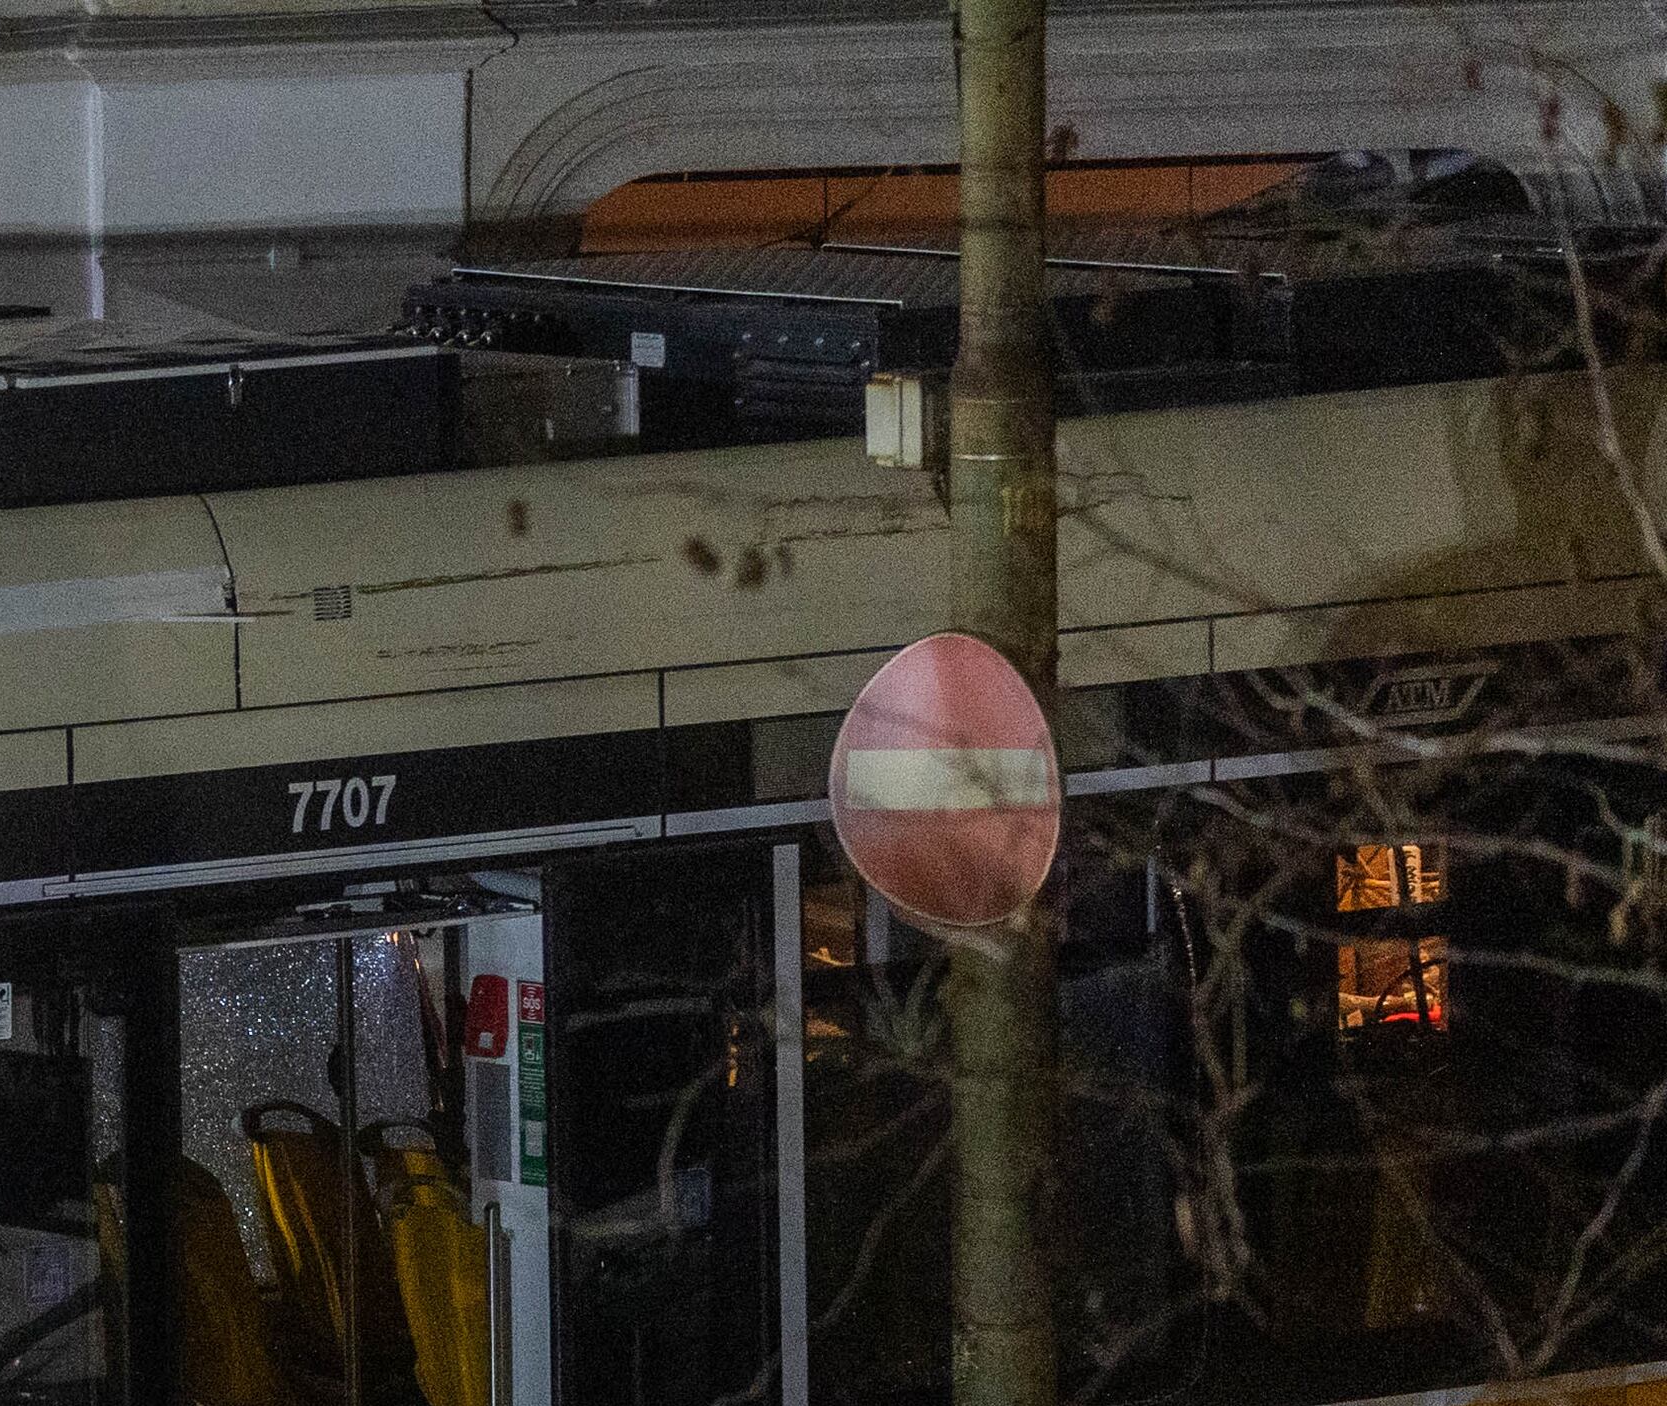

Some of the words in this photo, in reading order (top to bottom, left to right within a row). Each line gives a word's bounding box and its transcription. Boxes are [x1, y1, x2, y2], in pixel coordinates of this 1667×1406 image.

[1384, 677, 1450, 713] ATM
[288, 775, 396, 833] 7707
[523, 997, 541, 1010] SOS
